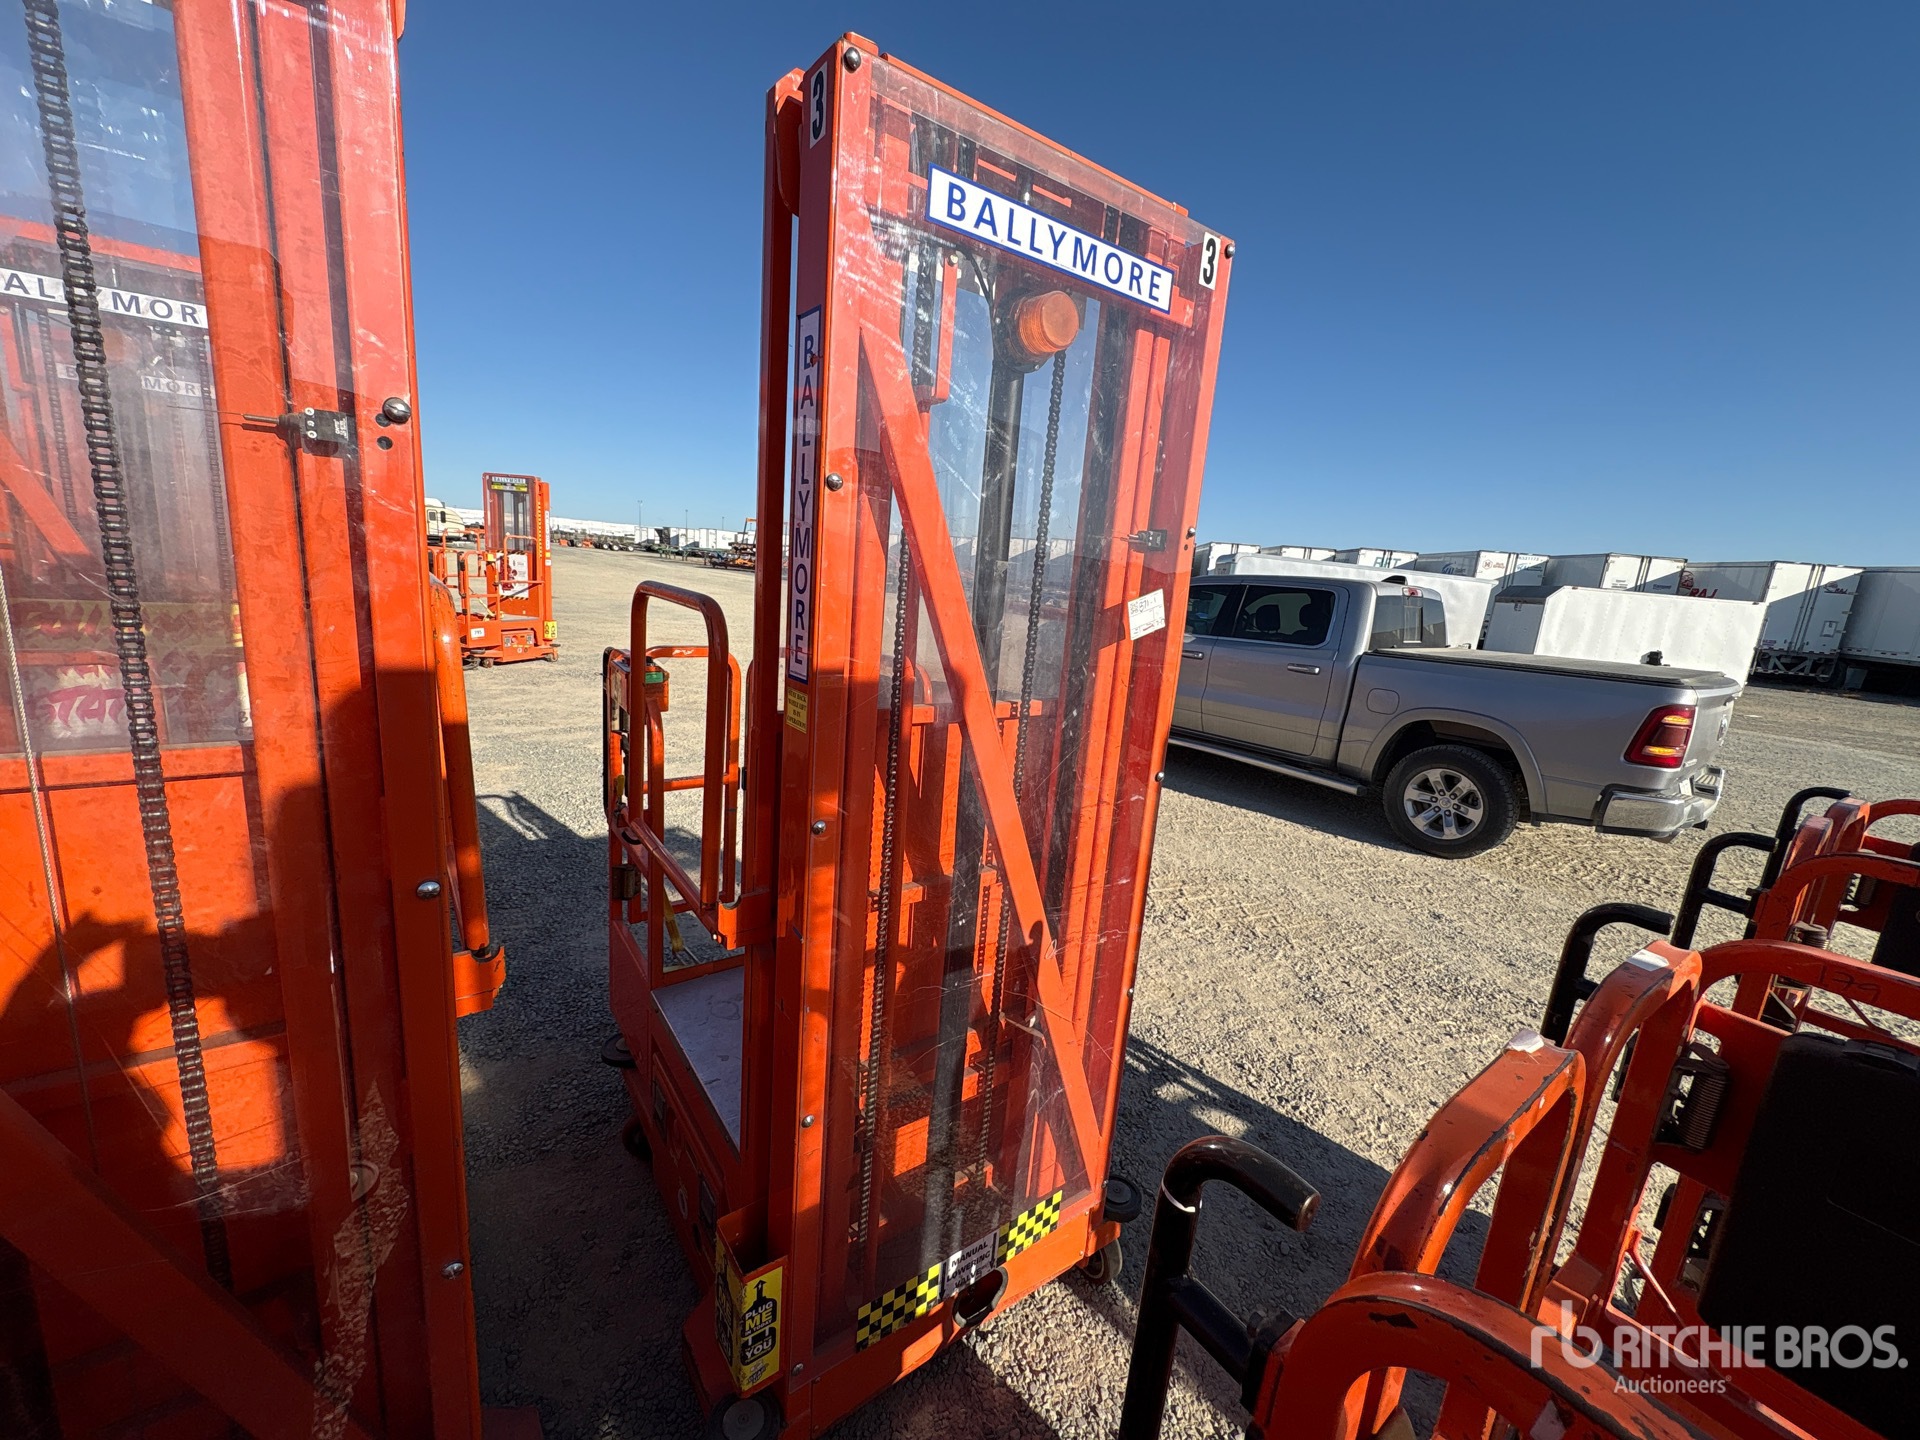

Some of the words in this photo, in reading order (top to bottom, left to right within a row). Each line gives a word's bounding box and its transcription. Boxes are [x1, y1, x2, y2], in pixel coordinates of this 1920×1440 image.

[810, 69, 825, 141] 3
[946, 180, 1163, 303] BALLYMORE
[1202, 237, 1216, 286] 3
[794, 333, 815, 666] BALLYMORE
[1689, 587, 1719, 599] RAJ
[946, 1250, 991, 1283] LOWERING
[951, 1241, 988, 1267] MANUAL
[954, 1267, 983, 1288] VALVE
[745, 1300, 773, 1321] PLUG
[745, 1308, 773, 1332] ME
[753, 1319, 772, 1333] TODAY
[745, 1338, 772, 1359] YOU
